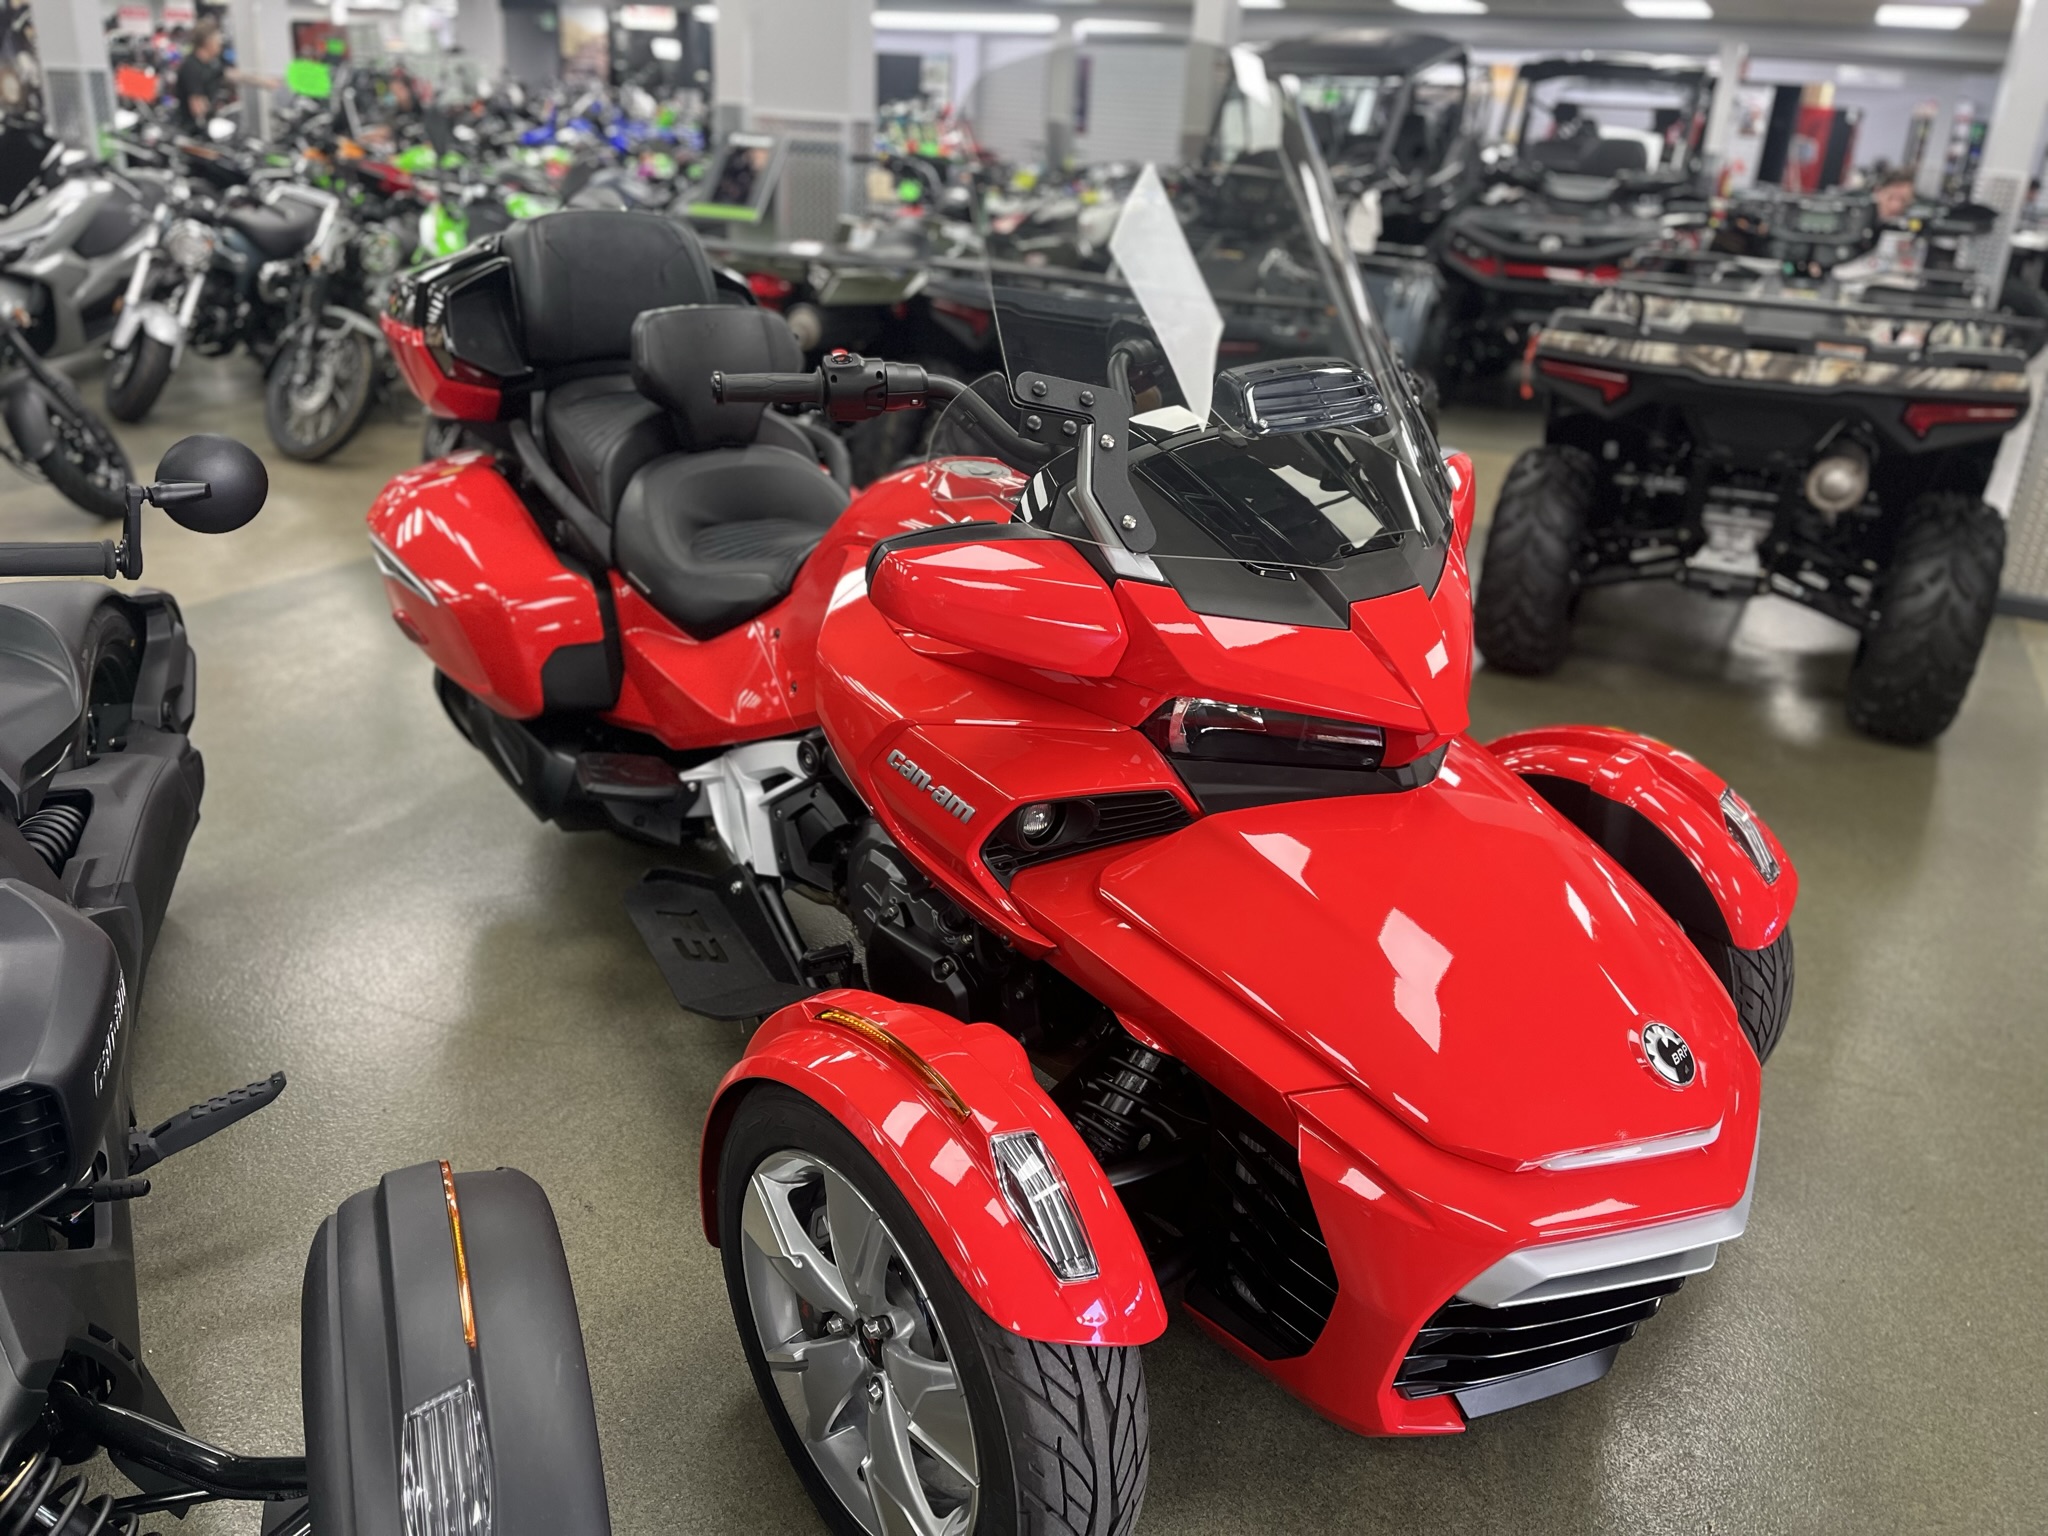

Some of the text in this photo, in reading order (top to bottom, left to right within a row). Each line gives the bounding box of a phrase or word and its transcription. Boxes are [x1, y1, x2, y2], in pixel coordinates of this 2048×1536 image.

[886, 748, 976, 824] can-am
[656, 909, 729, 963] F3
[1671, 1044, 1688, 1065] BRP
